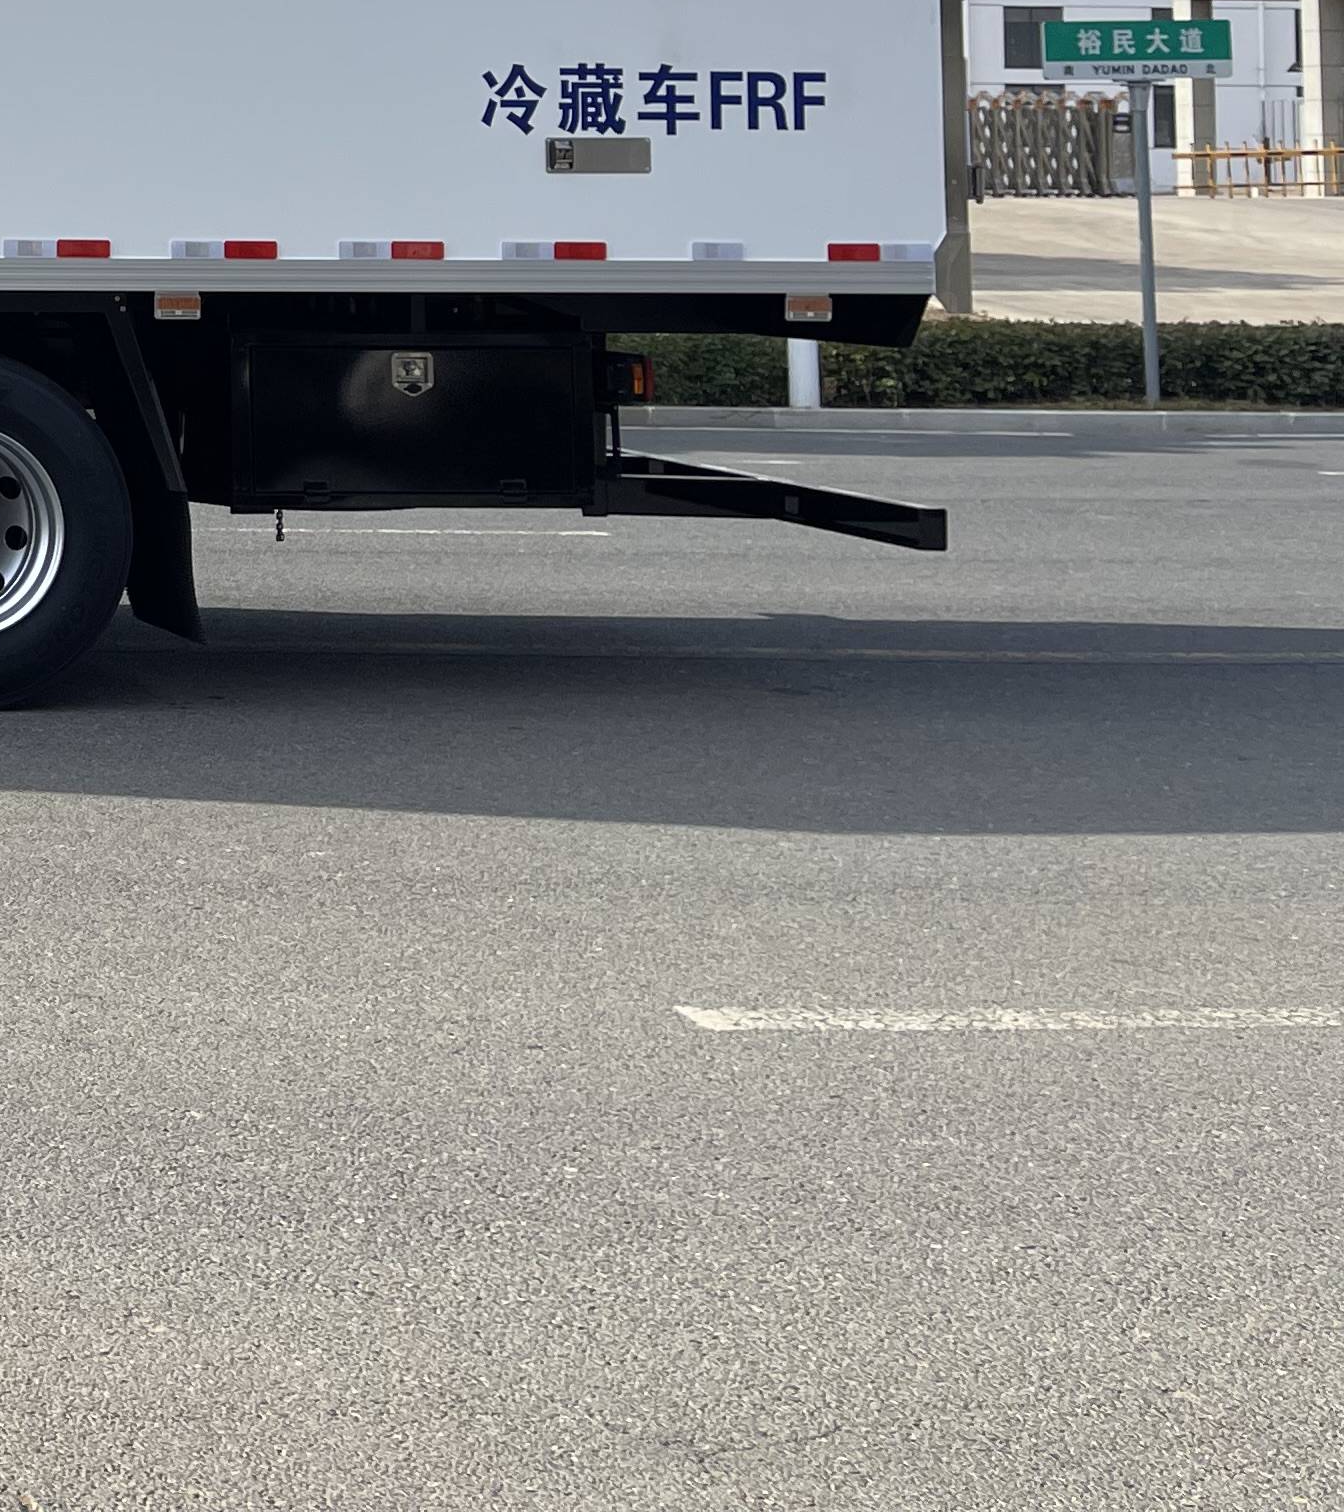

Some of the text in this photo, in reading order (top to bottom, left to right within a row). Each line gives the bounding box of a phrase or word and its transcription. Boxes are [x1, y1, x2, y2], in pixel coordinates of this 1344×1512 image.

[1076, 28, 1205, 56] 裕民大道
[1092, 64, 1188, 76] YUMIN DADAO
